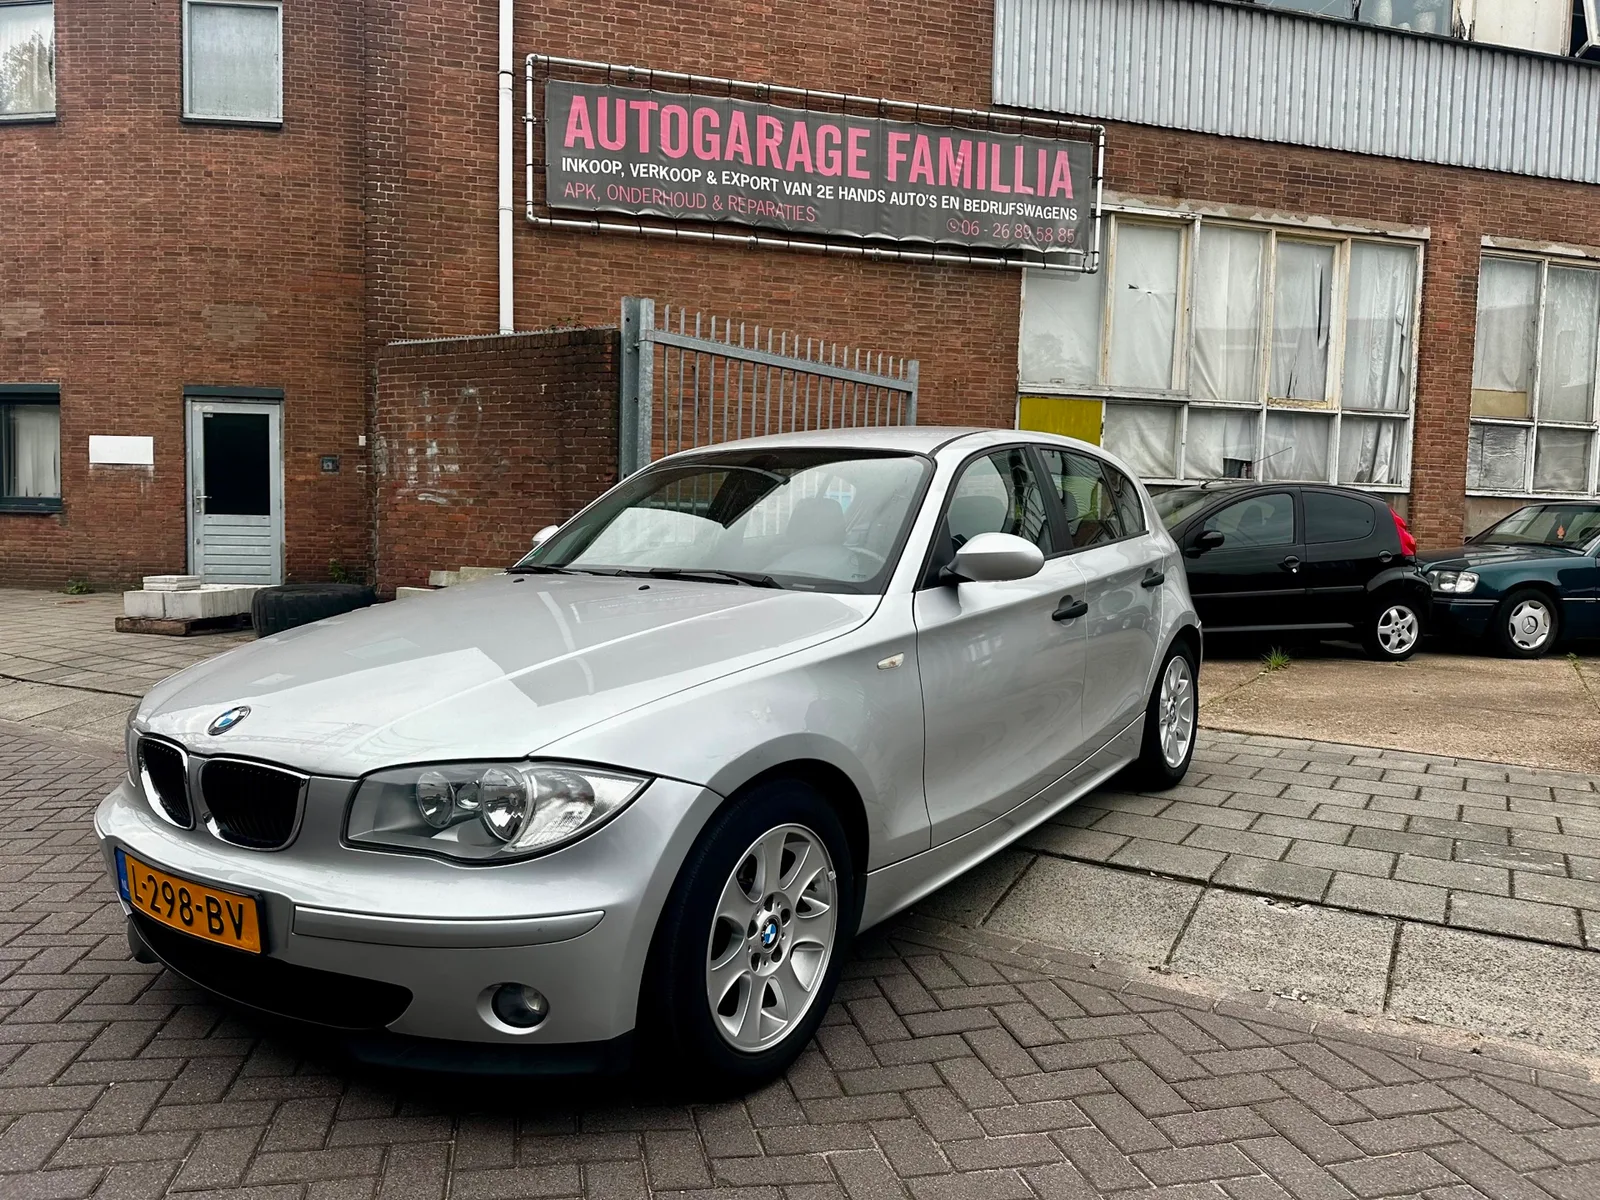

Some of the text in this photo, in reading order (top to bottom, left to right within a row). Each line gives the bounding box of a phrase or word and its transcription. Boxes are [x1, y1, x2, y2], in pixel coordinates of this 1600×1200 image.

[564, 95, 1074, 199] AUTOGARAGE FAMILLIA
[561, 157, 1078, 221] INKOOP, VERKOOP & EXPORT VAN 2E HANDS AUTO'S EN BEDRIJFSWAGENS
[564, 182, 816, 222] APK, ONDERHOUD & REPARATIES
[961, 219, 980, 236] 06
[992, 222, 1010, 239] 26
[1014, 223, 1032, 240] 89
[1036, 226, 1054, 242] 58
[1057, 227, 1075, 244] 85
[131, 863, 244, 940] L-298-BV
